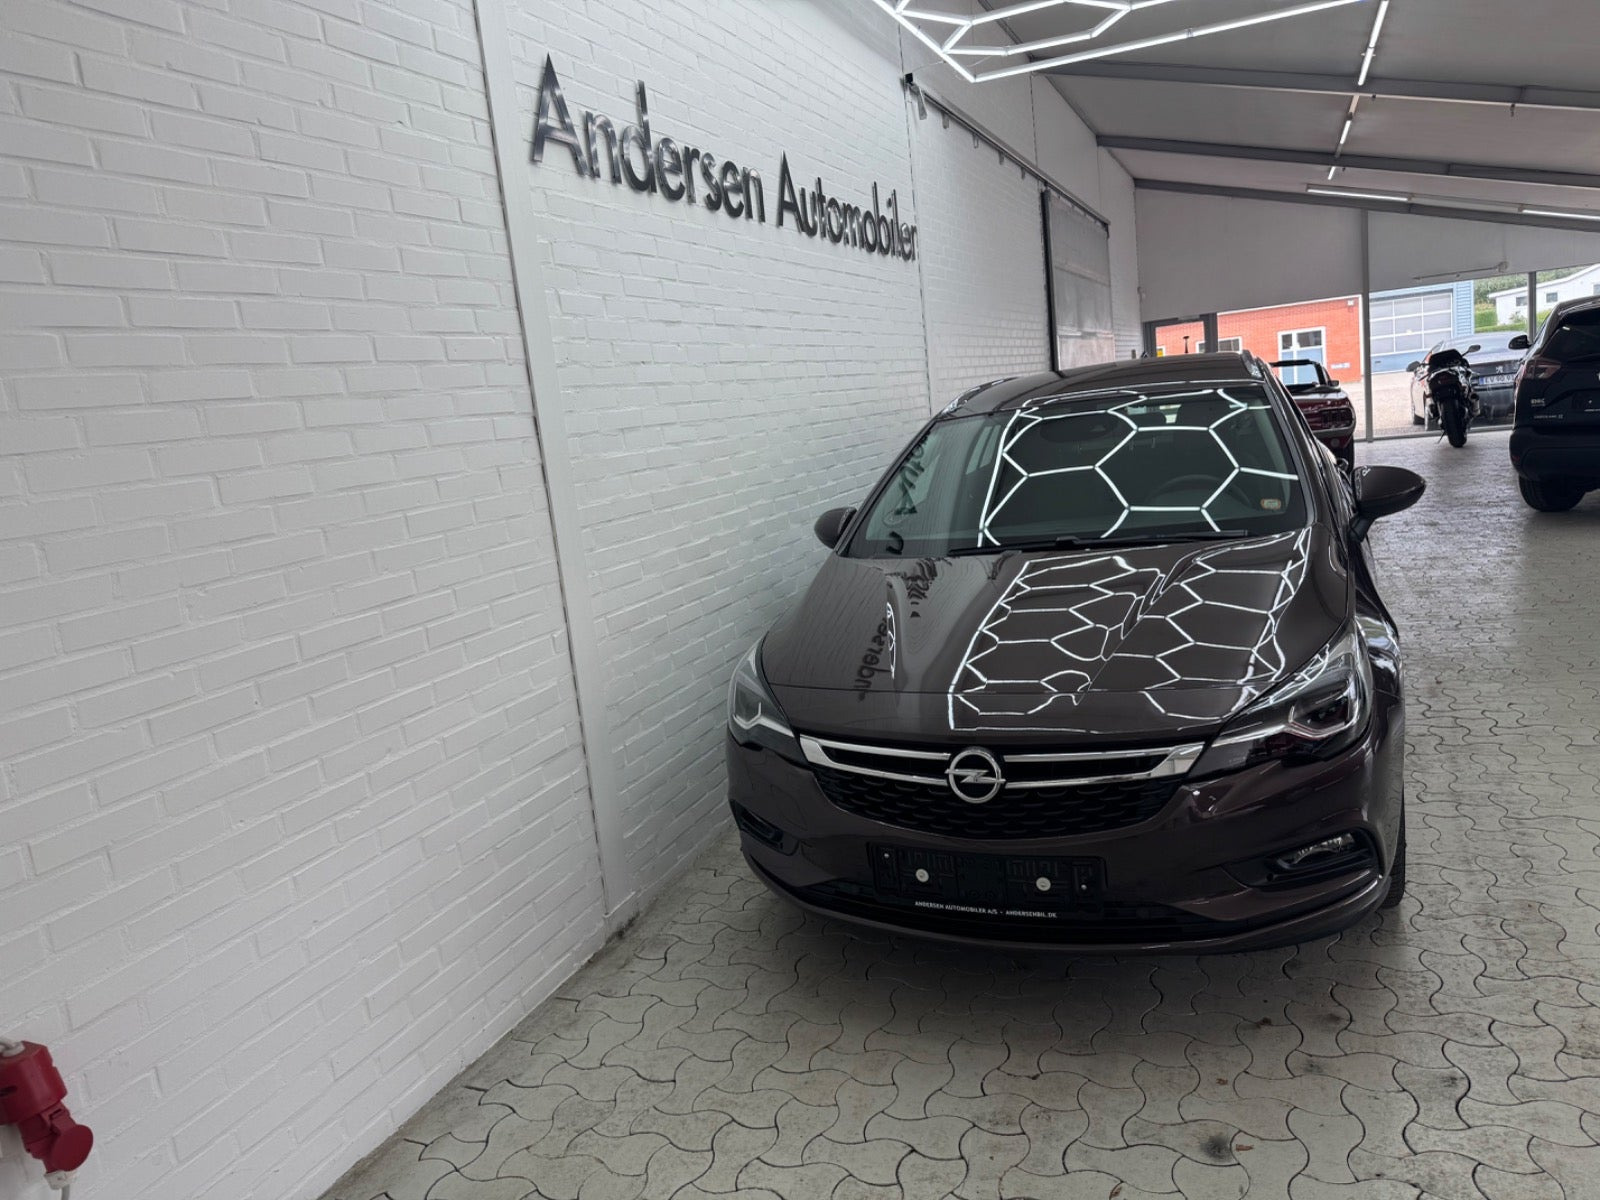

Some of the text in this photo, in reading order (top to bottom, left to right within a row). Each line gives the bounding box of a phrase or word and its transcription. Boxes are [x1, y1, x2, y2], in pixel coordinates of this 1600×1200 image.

[531, 53, 918, 261] Andersen Automobiler
[915, 901, 944, 909] ANDERSEN
[945, 904, 986, 913] AUTOMOBILER
